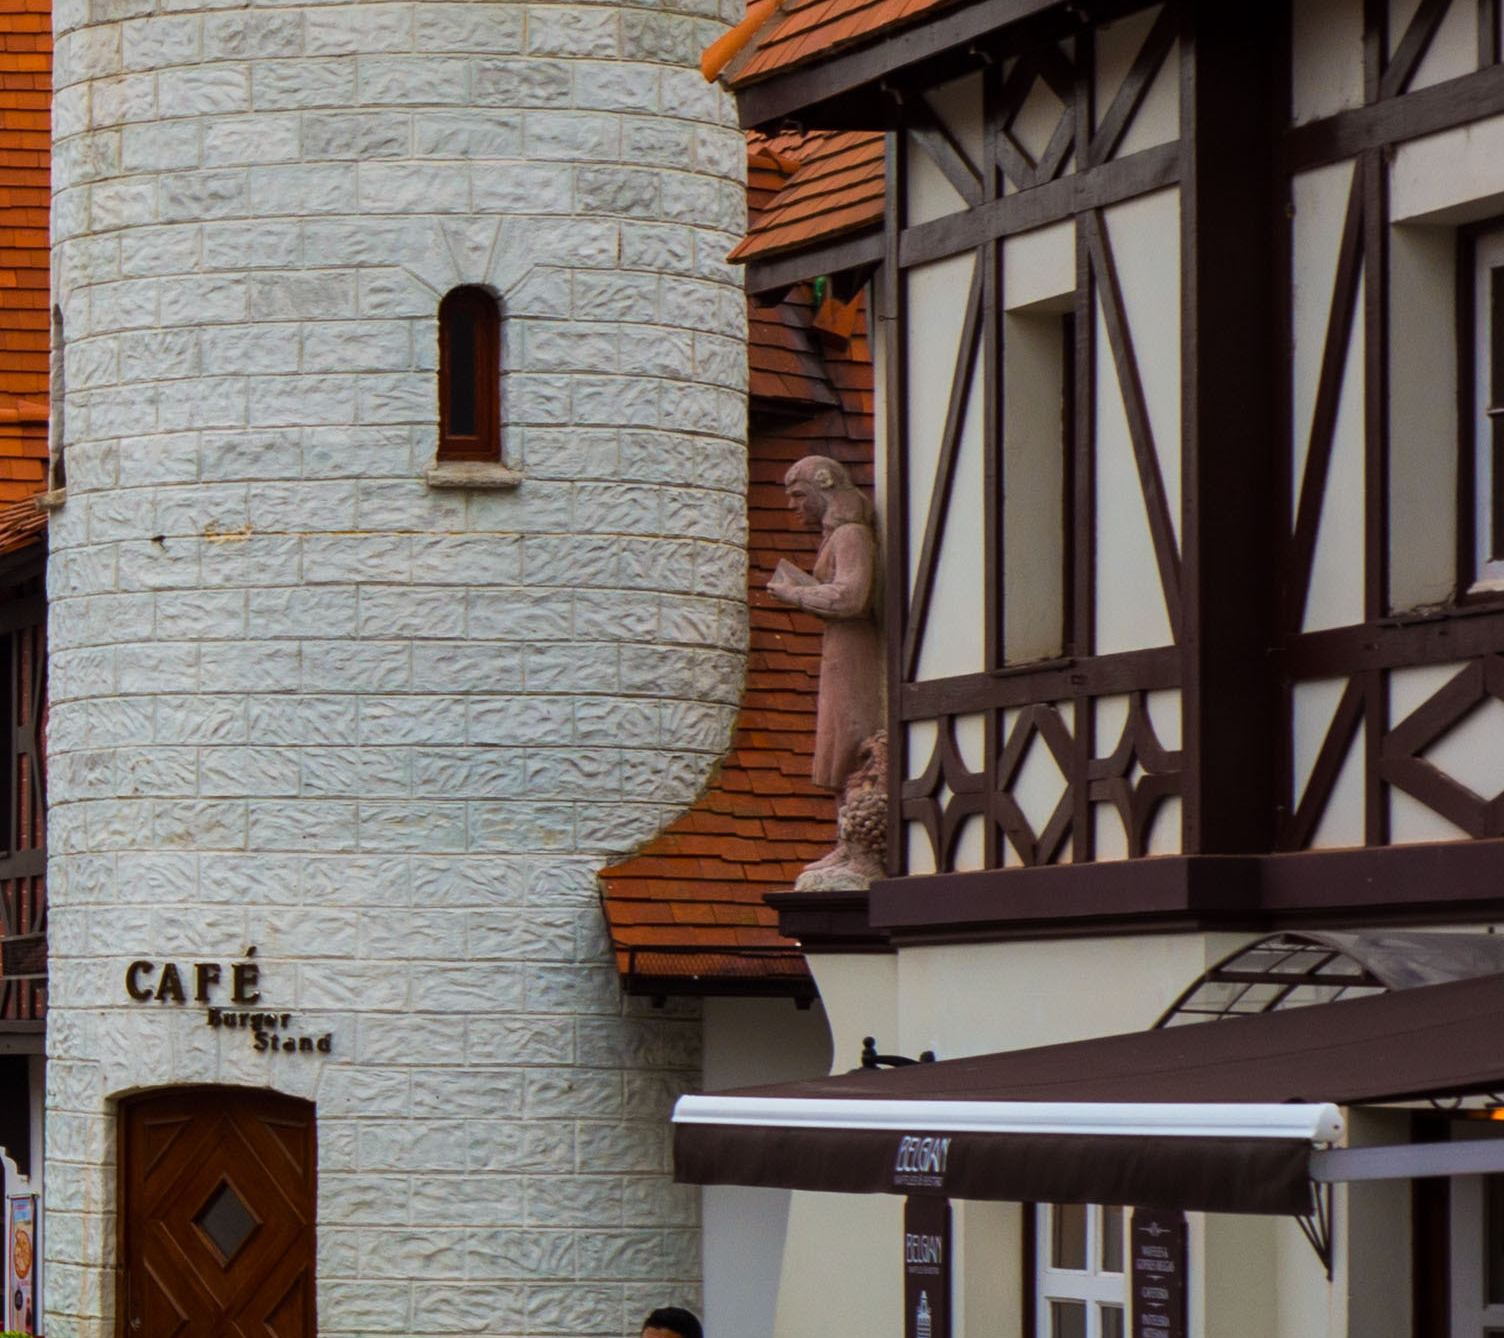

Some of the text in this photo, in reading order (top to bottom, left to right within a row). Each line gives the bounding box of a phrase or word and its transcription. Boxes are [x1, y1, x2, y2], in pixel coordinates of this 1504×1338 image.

[125, 945, 262, 1004] CAFÉ
[207, 1007, 292, 1032] Burger
[253, 1031, 333, 1053] Stand
[895, 1135, 952, 1173] BELGIAN
[905, 1233, 942, 1264] BELGIAN
